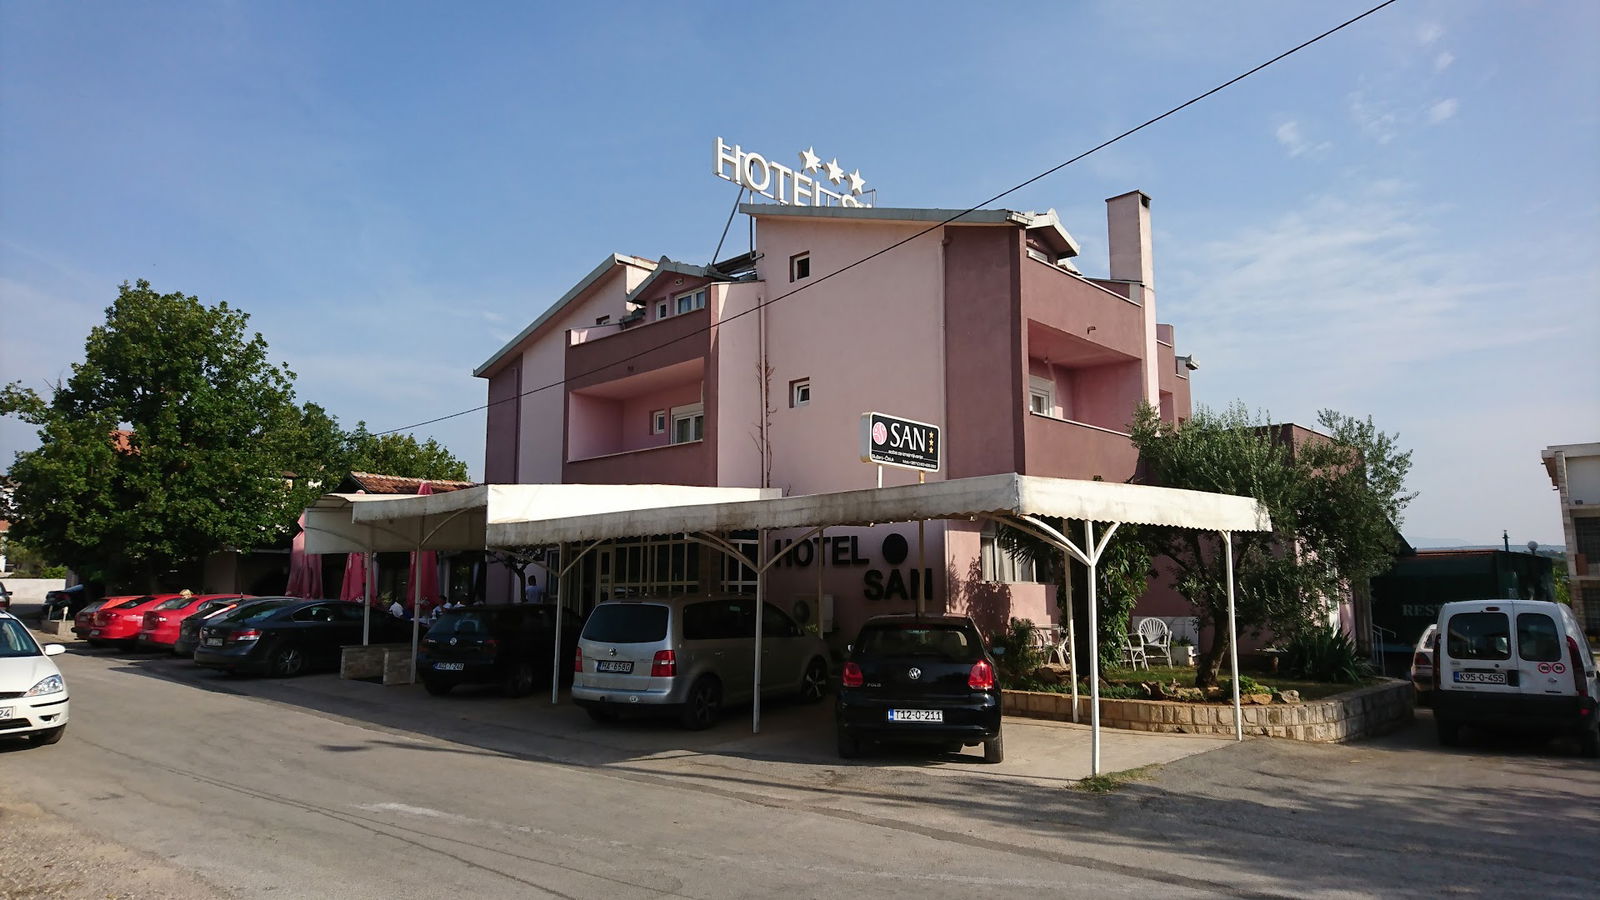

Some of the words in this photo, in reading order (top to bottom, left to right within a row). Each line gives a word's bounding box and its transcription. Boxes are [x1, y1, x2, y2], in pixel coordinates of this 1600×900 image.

[890, 422, 926, 452] SAN
[774, 535, 869, 568] HOTEL
[863, 568, 933, 601] SAN
